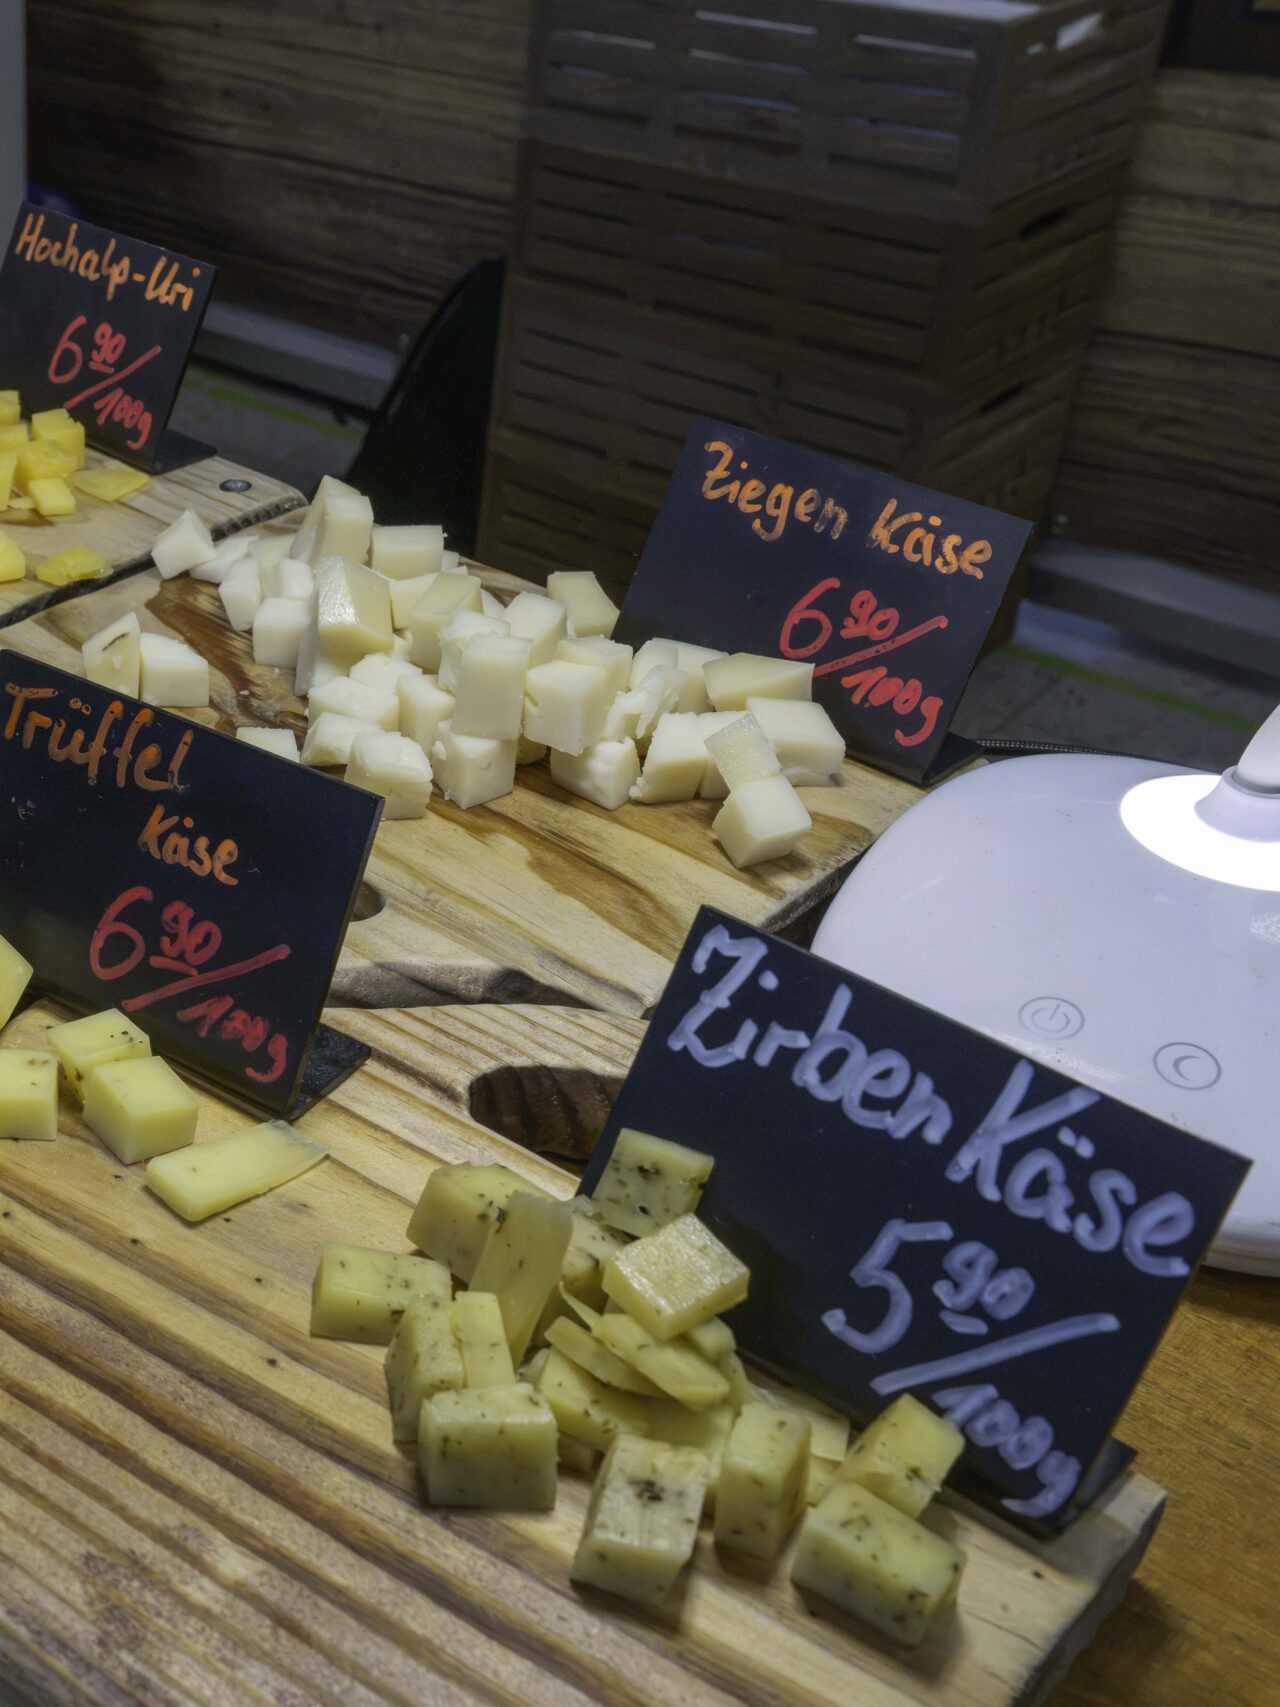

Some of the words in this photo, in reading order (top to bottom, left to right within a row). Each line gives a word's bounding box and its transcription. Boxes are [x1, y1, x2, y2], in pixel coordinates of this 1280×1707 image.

[15, 213, 201, 311] Hochalp-Uri
[702, 440, 849, 542] Ziegen
[867, 498, 993, 580] Käse
[5, 683, 194, 792] Trüffel
[137, 804, 239, 886] Käse
[667, 924, 953, 1145] Zirben
[945, 1058, 1195, 1277] Käse
